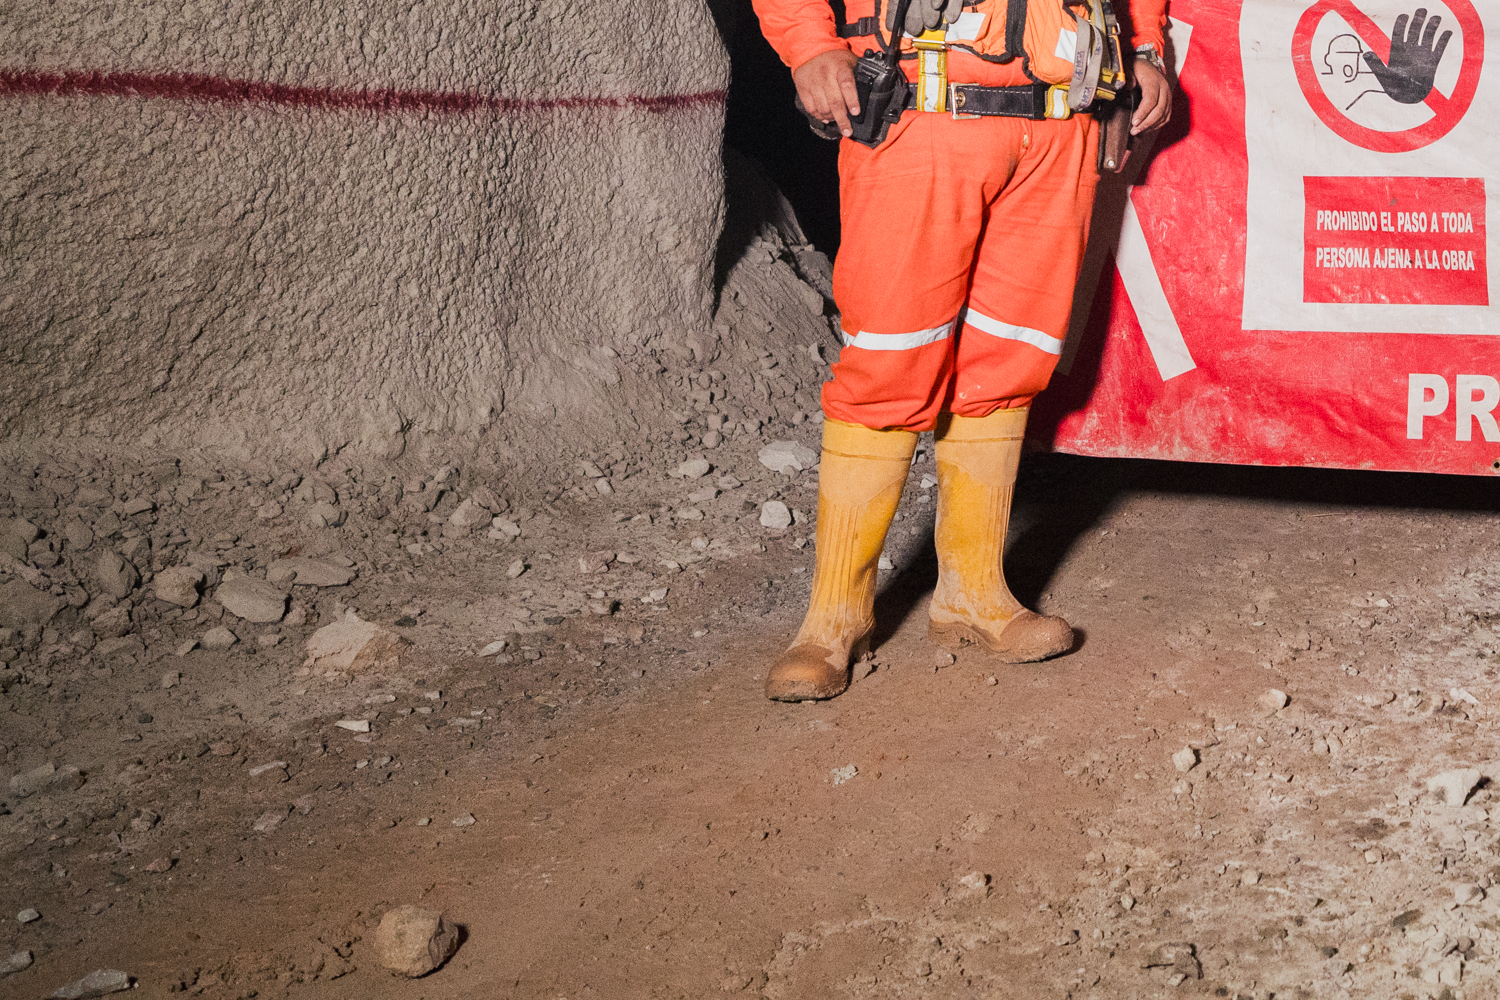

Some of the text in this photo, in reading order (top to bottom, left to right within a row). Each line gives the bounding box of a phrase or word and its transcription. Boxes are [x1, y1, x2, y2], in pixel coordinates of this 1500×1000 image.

[1316, 210, 1474, 233] PROHIBIDO EL PASO A TODA
[1316, 247, 1475, 271] PERSONA AJENA A LA OBRA
